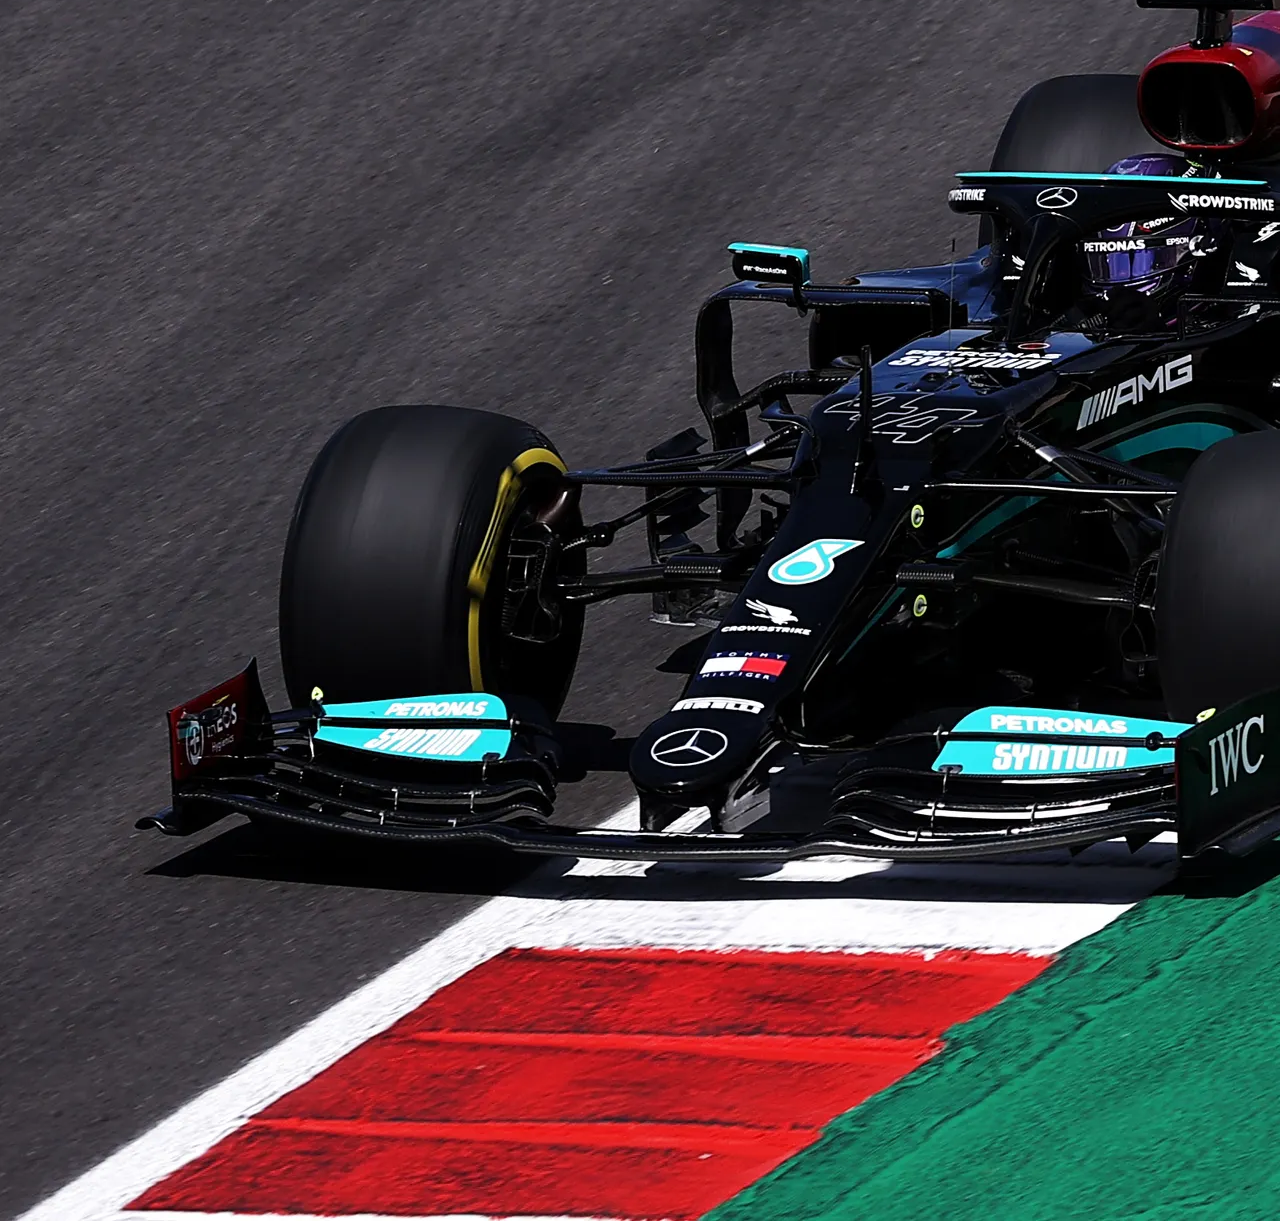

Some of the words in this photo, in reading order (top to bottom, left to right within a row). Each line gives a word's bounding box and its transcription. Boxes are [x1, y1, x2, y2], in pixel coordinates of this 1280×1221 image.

[1178, 194, 1275, 211] CROWDSTRIKE
[1084, 239, 1146, 252] PETRONAS
[1166, 236, 1189, 246] EPSON
[905, 349, 1062, 360] PETRONAS
[888, 355, 1052, 370] SYNTIUM
[721, 625, 812, 636] CROWDSTRIKE
[716, 651, 784, 660] TOMMY
[702, 671, 771, 681] HILFIGER
[384, 701, 489, 717] PETRONAS
[671, 697, 765, 714] PIRELLI
[990, 714, 1128, 734] PETRONAS
[363, 729, 482, 756] SYNTIUM
[992, 744, 1129, 771] SYNTIUM
[1208, 714, 1265, 796] IWC
